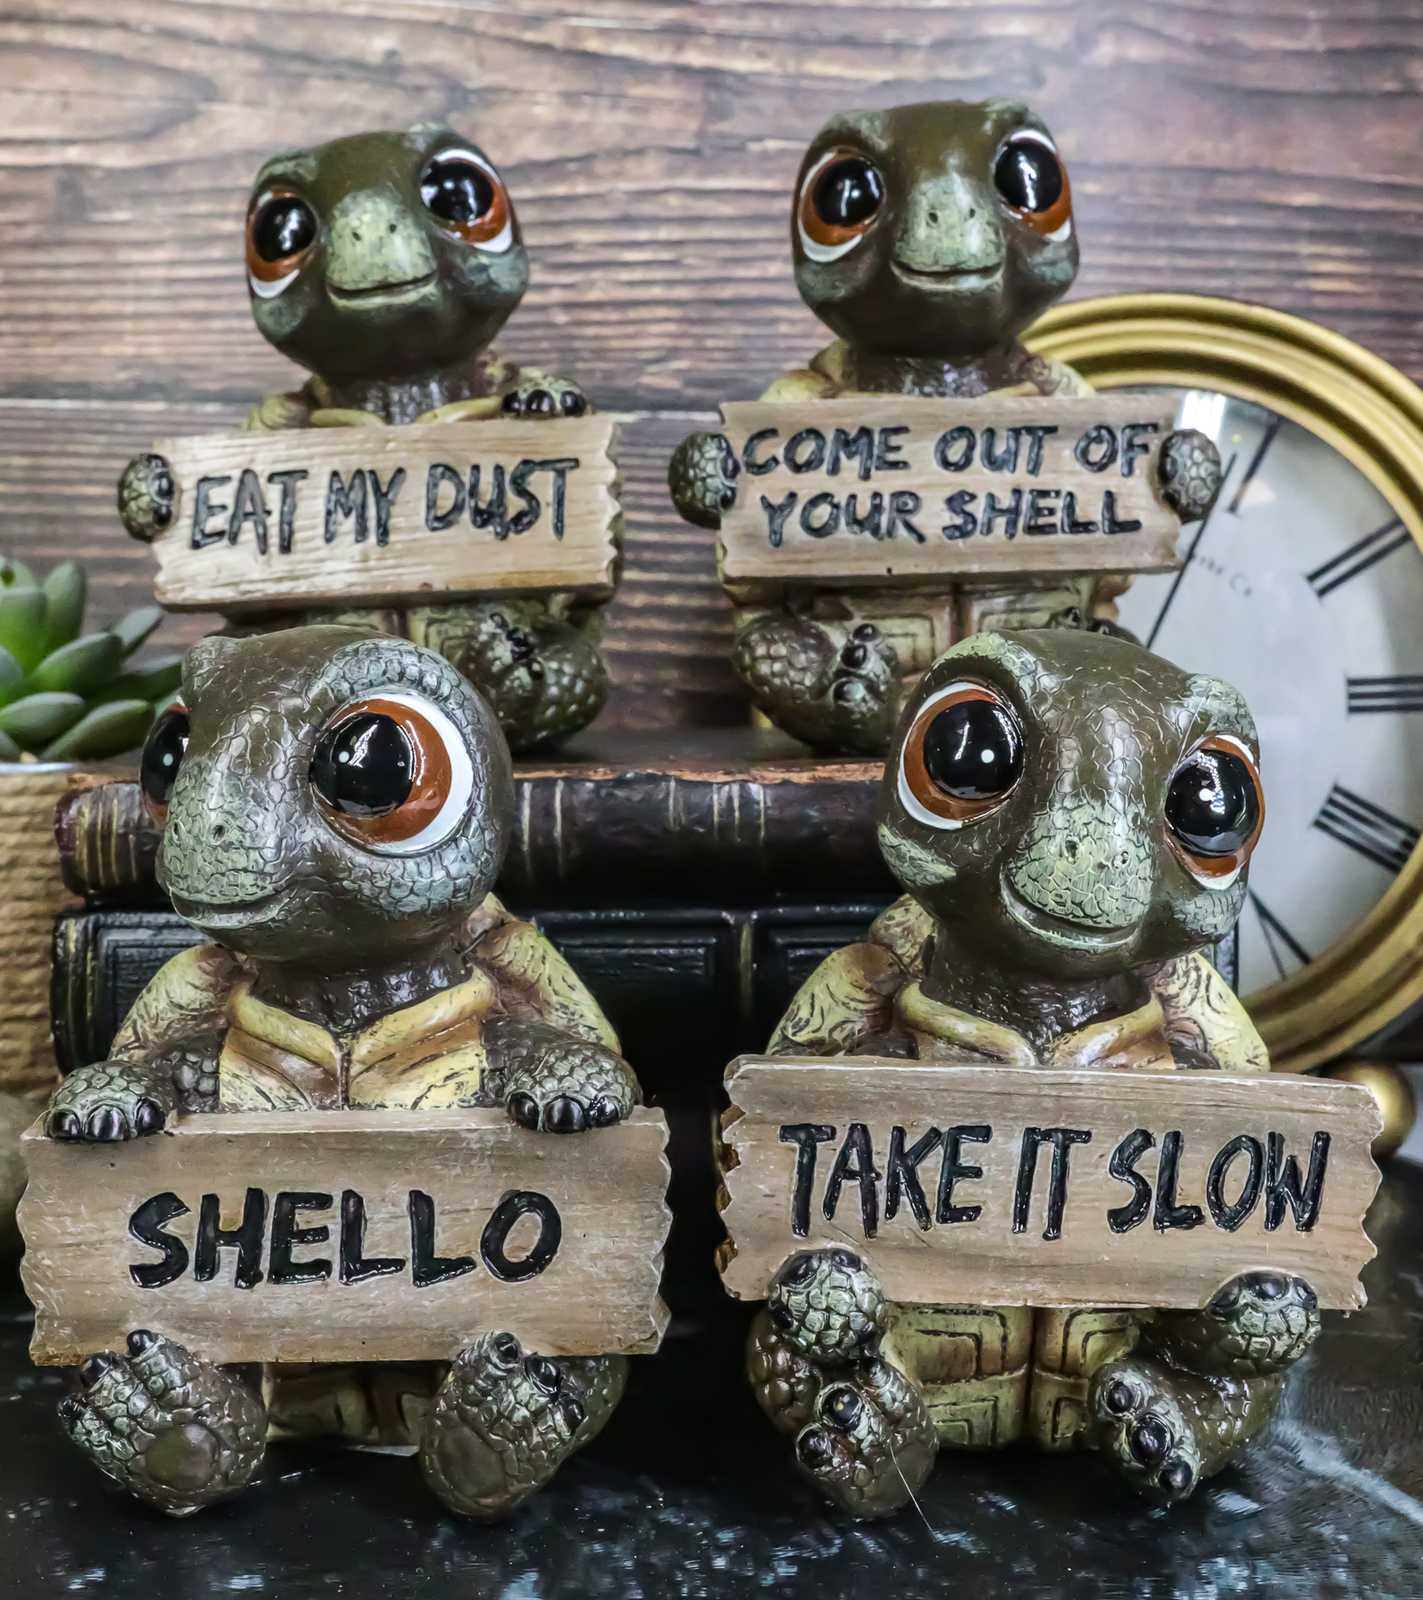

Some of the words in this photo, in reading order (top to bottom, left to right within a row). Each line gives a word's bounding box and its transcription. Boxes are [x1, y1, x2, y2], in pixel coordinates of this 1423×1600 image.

[742, 426, 911, 481] COME
[934, 425, 1059, 477] OUT
[1073, 422, 1160, 478] OF
[190, 467, 308, 556] EAT
[323, 467, 406, 547] MY
[424, 457, 580, 542] DUST
[760, 491, 926, 548] YOUR
[941, 488, 1142, 541] SHELL
[779, 1123, 994, 1239] TAKE
[1010, 1126, 1092, 1241] IT
[1106, 1129, 1331, 1234] SLOW
[128, 1187, 563, 1290] SHELLO
